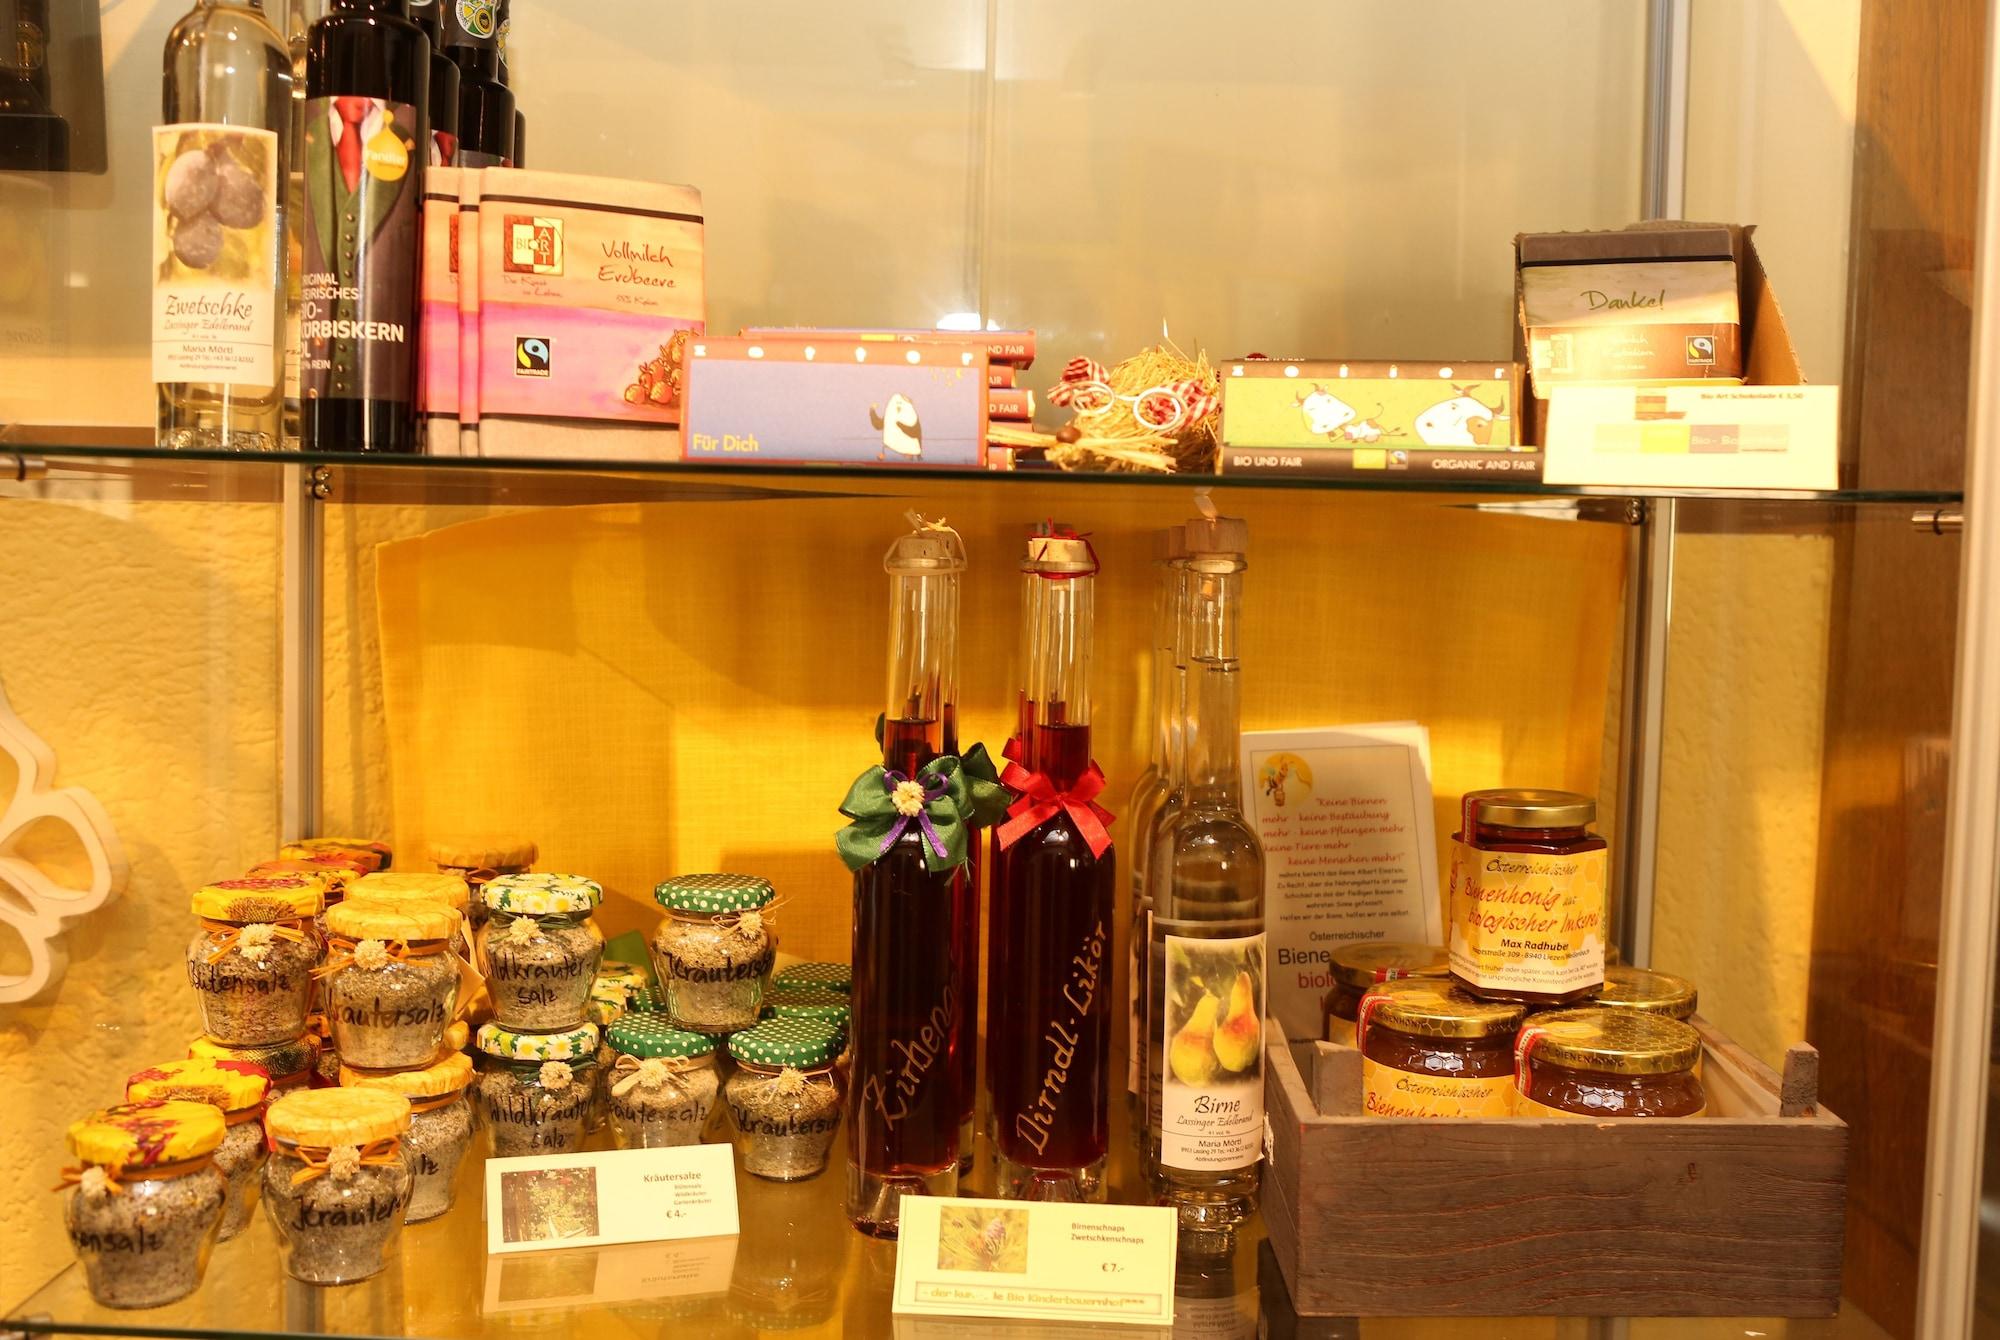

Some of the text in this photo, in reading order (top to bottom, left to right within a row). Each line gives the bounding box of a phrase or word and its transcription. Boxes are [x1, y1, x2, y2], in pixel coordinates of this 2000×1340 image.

[601, 240, 674, 268] Vollmilch
[302, 272, 338, 286] RIGINAL
[598, 264, 677, 289] Erdbeere
[303, 286, 360, 301] EIRISCHES
[1580, 288, 1665, 311] Danke!
[165, 291, 253, 320] Zwetschke
[987, 345, 1025, 354] ND FAIR
[311, 359, 331, 370] REIN
[989, 375, 1002, 385] AIR
[999, 403, 1019, 413] FAIR
[693, 432, 759, 453] Für Dich
[1233, 455, 1303, 468] BIO UND FAIR
[1431, 458, 1536, 471] ORGANIC AND FAIR
[1308, 928, 1385, 943] Österreichischer
[1500, 938, 1522, 949] Max
[1278, 947, 1331, 966] Biene
[1194, 1095, 1241, 1114] Birne
[1176, 1114, 1216, 1132] Lassinger
[1198, 1139, 1221, 1148] Maria
[643, 1170, 702, 1183] Kräutersalze
[666, 1210, 673, 1219] €
[1071, 1222, 1125, 1233] Birnenschnaps
[1071, 1233, 1145, 1245] Zwetschkenschnaps
[1101, 1262, 1108, 1272] €
[1007, 1292, 1025, 1302] Bio
